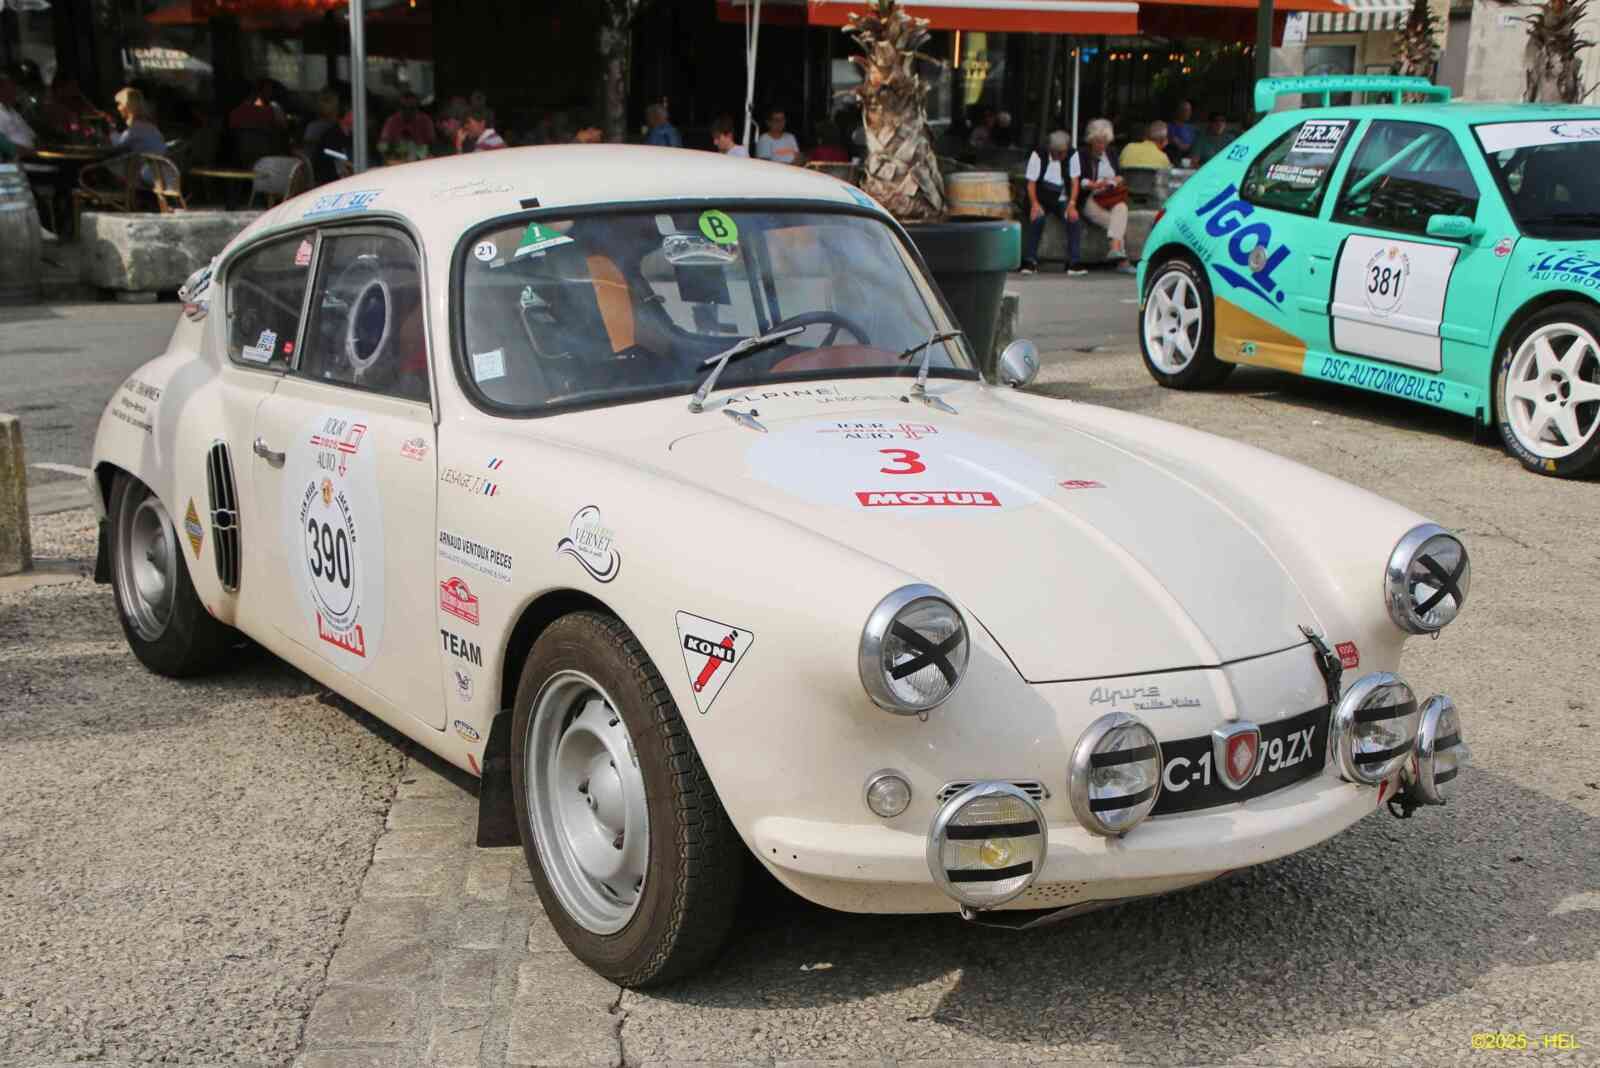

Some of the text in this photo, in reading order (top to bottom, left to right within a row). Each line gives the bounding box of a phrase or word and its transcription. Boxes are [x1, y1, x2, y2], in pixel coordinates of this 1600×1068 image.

[706, 216, 729, 238] B
[1368, 265, 1402, 297] 381
[1320, 356, 1446, 403] DSC AUTOMOBILES
[727, 388, 833, 405] ALPINE
[878, 448, 926, 475] 3
[867, 492, 995, 506] MOTUL
[439, 530, 462, 550] ARNAUD
[461, 540, 490, 561] VENTOUX
[489, 549, 512, 570] PIECES
[575, 526, 613, 552] VERNET
[307, 518, 351, 589] 390
[440, 628, 483, 667] TEAM
[687, 637, 734, 660] KONI
[1089, 685, 1161, 707] Alpine
